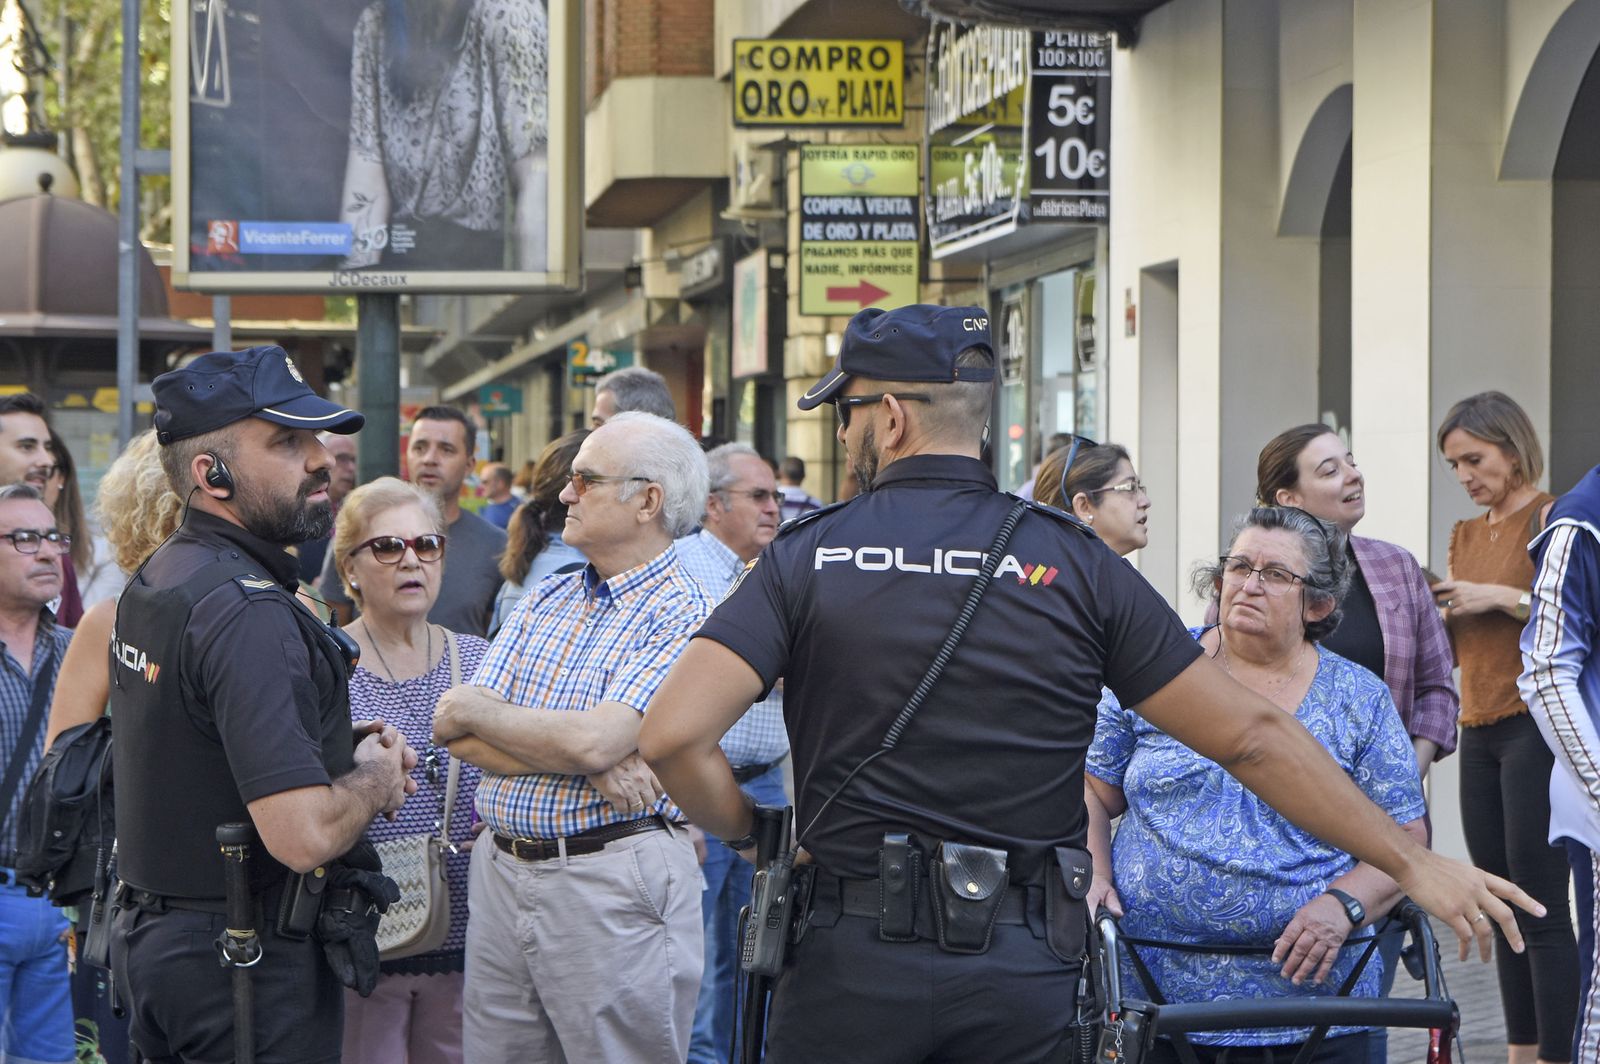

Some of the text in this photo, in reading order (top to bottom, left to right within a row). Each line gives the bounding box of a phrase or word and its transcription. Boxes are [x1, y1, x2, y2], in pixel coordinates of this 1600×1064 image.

[749, 45, 890, 71] COMPRO
[741, 79, 897, 117] ORO Y PLATA
[1048, 84, 1095, 126] 5€
[891, 149, 915, 160] ORO
[1034, 137, 1106, 180] 10€
[803, 197, 913, 215] COMPRA VENTA
[243, 228, 347, 247] VicenteFerrer
[803, 222, 824, 240] DE
[826, 222, 858, 240] ORO
[860, 222, 872, 240] Y
[873, 222, 917, 240] PLATA
[804, 245, 914, 259] PAGAMOS MÁS QUE
[328, 271, 408, 287] JCDecaux
[805, 264, 844, 276] NADIE,
[962, 318, 988, 331] CNP
